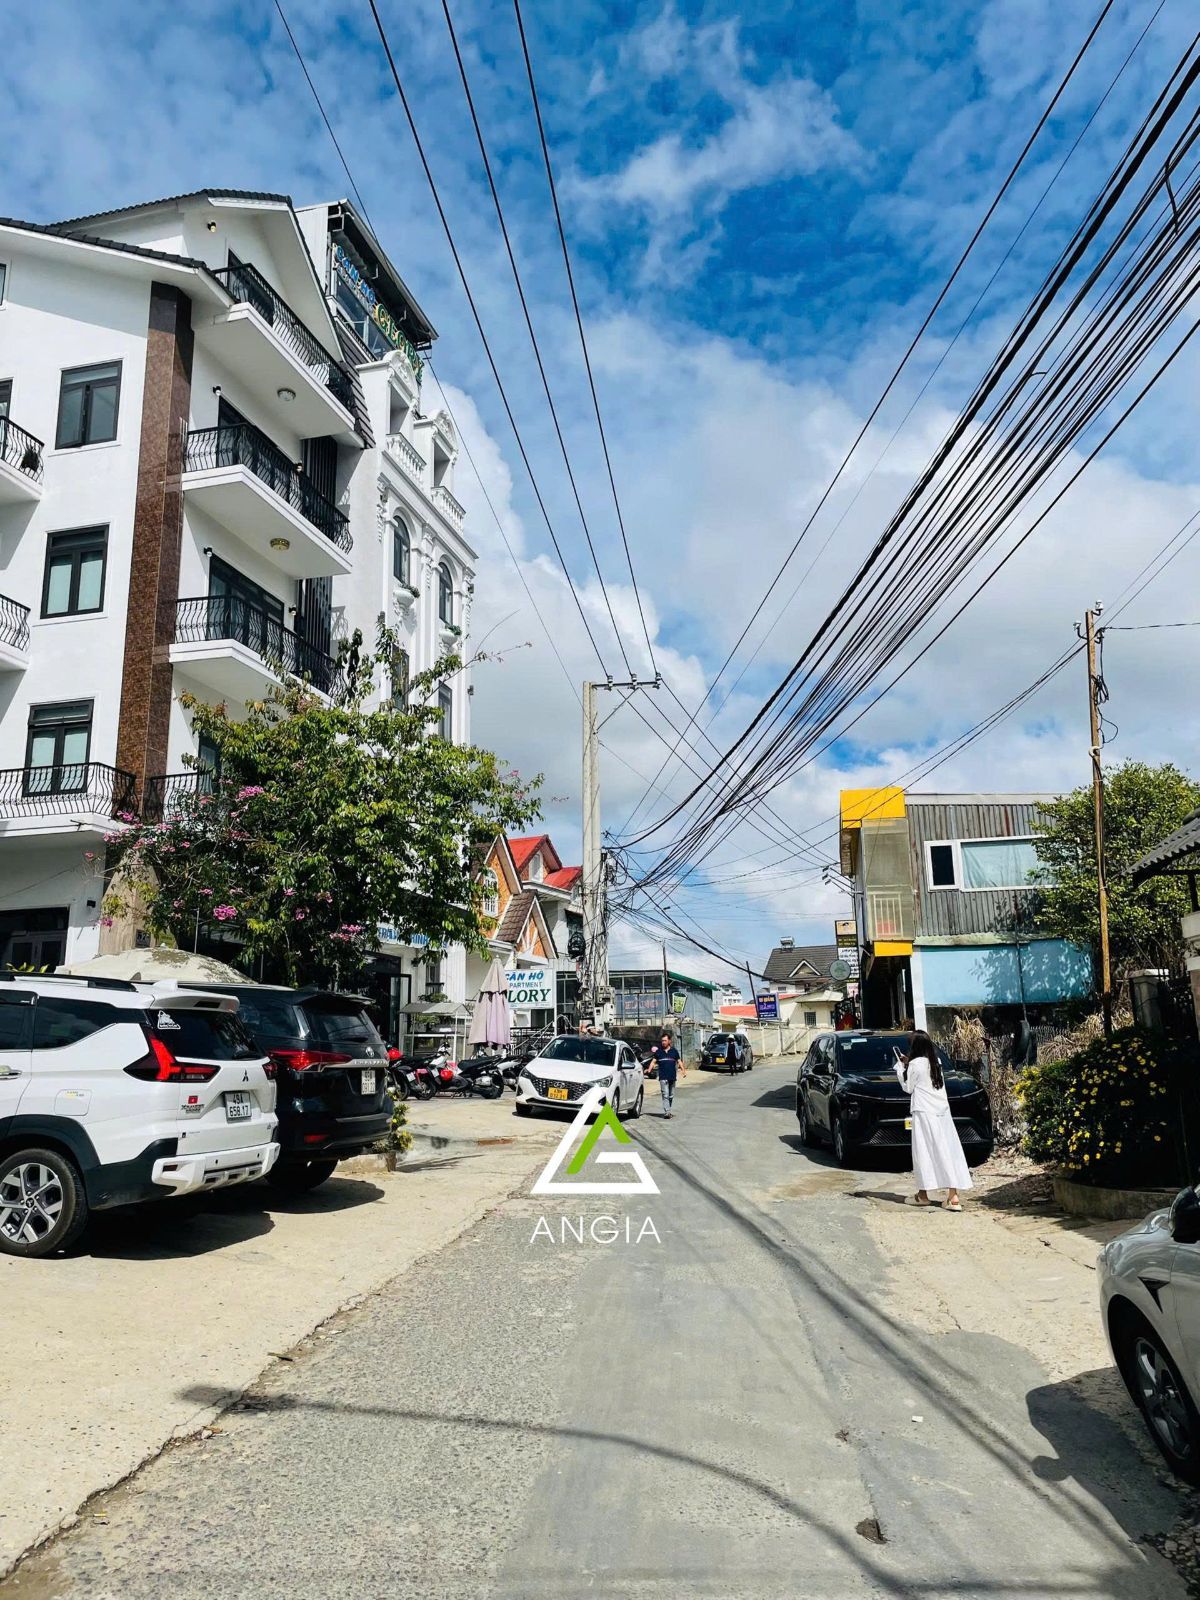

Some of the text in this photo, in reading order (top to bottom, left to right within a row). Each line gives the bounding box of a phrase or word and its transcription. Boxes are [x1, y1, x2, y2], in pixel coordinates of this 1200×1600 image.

[508, 981, 543, 989] PARTMENT
[507, 988, 552, 1003] LORY
[232, 1093, 244, 1104] 49A
[229, 1105, 249, 1117] 658.17
